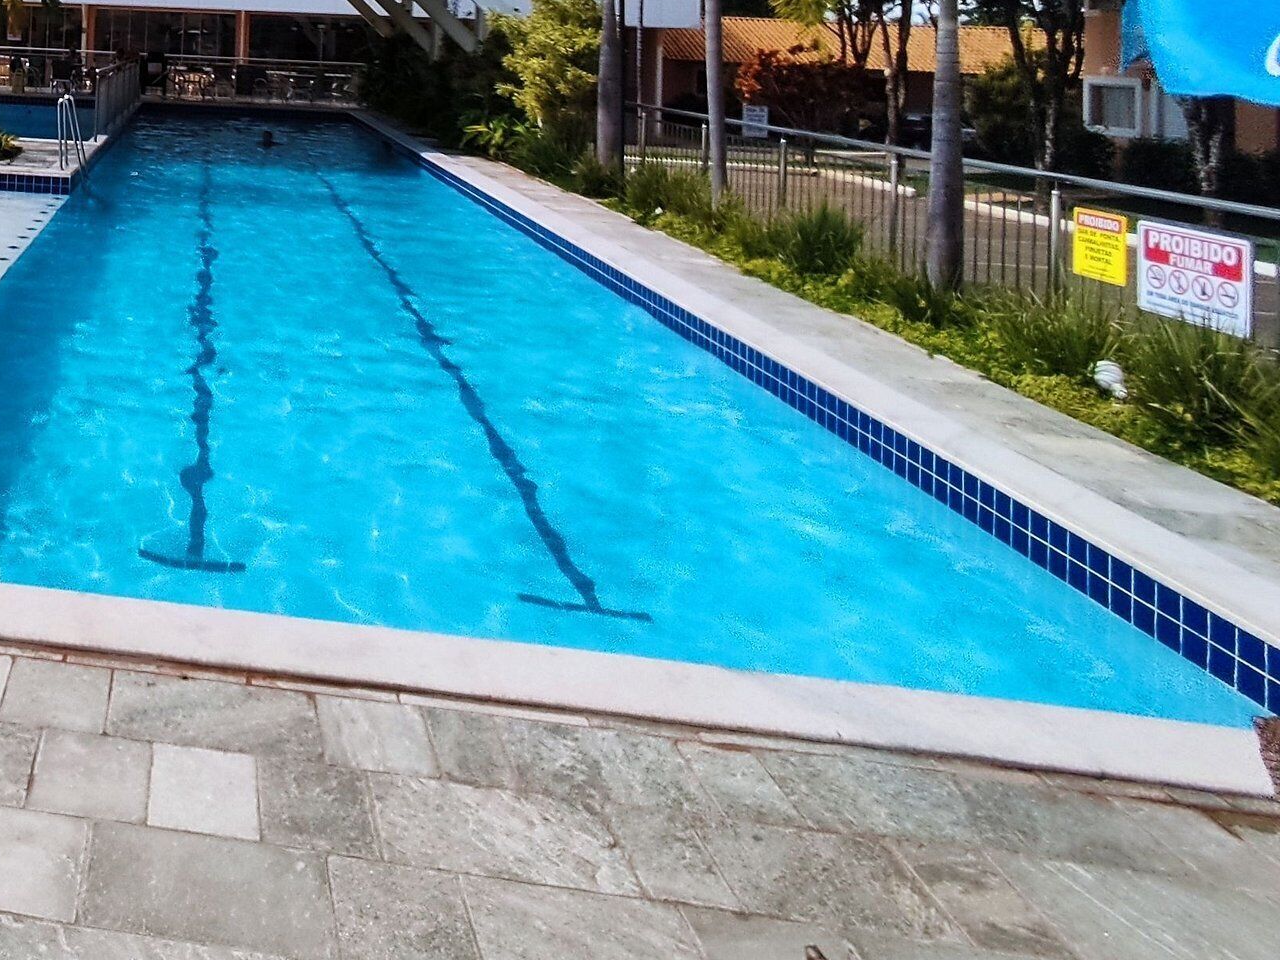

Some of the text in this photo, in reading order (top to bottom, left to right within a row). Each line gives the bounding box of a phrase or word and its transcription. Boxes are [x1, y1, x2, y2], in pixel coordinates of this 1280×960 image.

[1079, 214, 1119, 232] PROIBIDO
[1149, 231, 1237, 266] PROIBIDO
[1169, 254, 1213, 275] FUMAR
